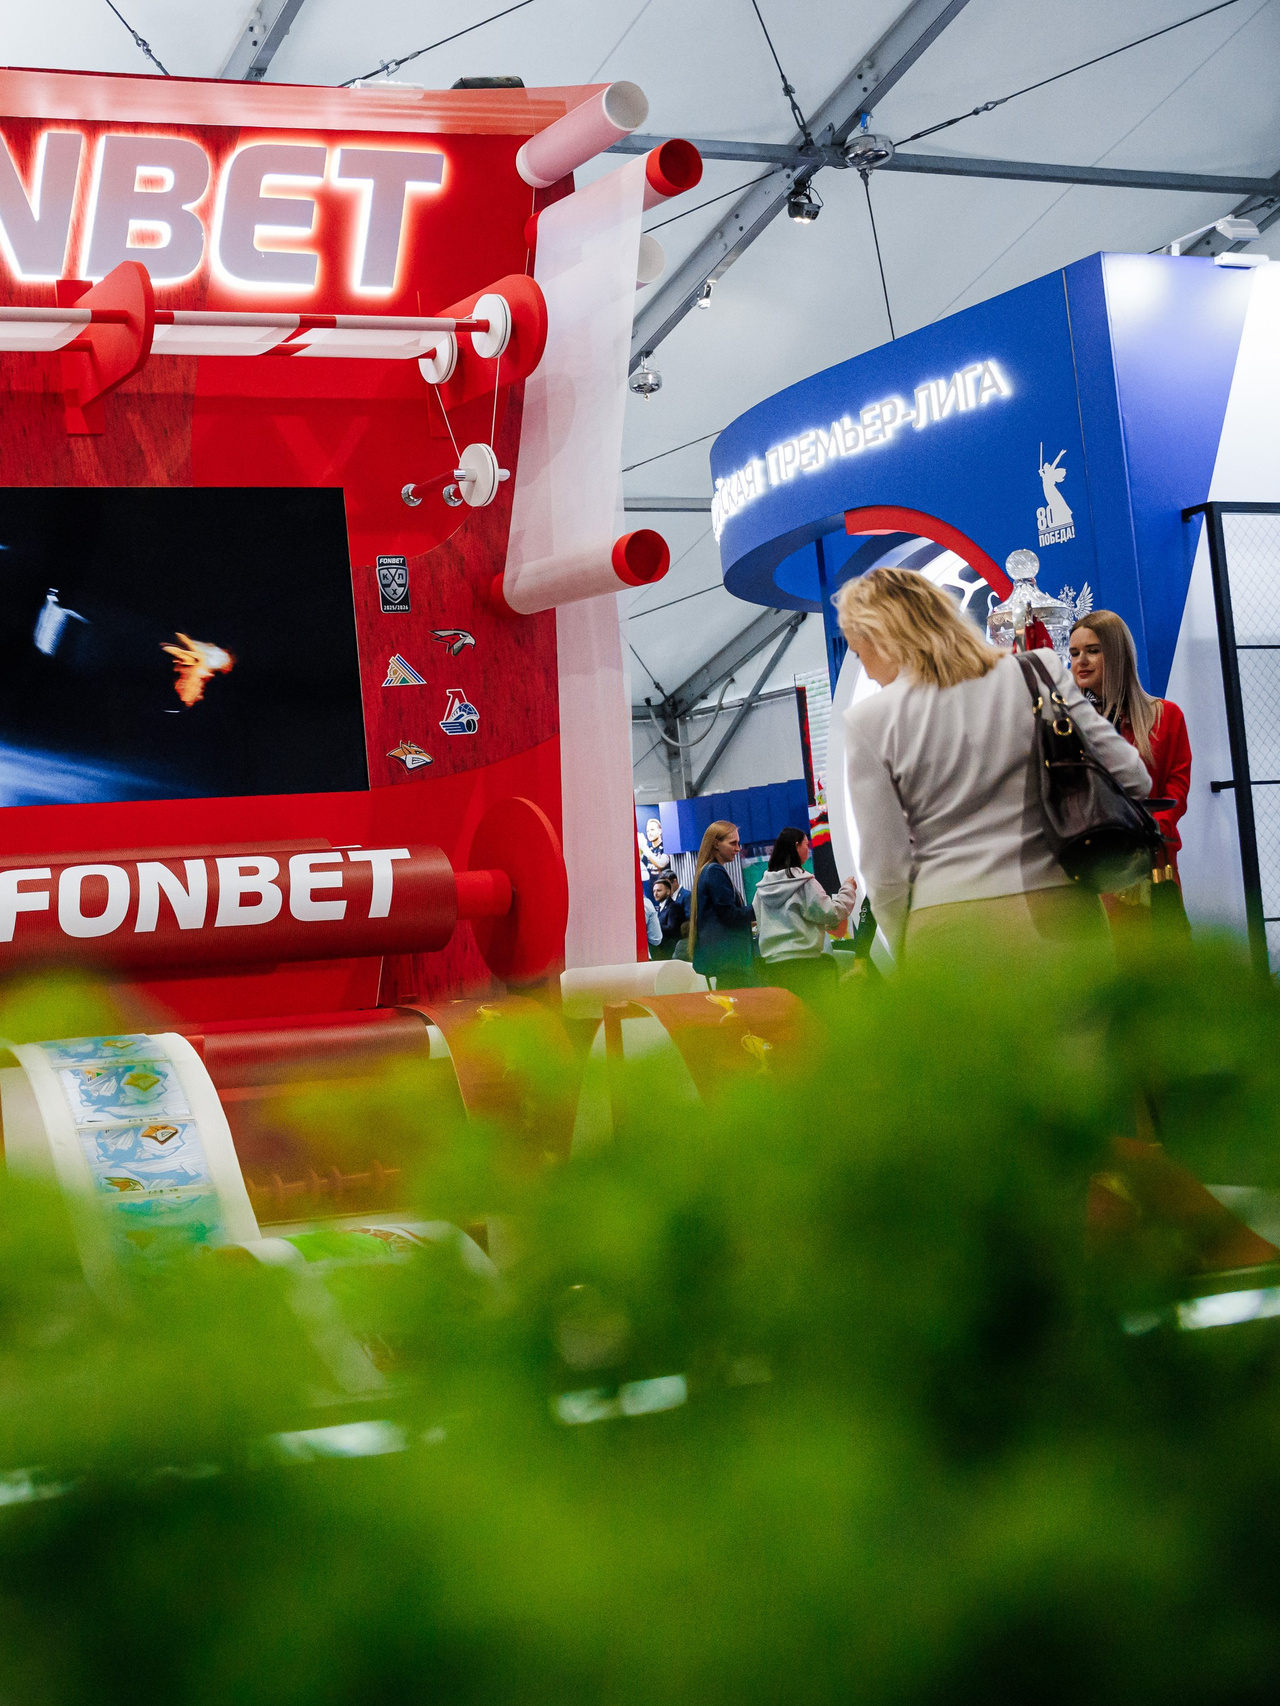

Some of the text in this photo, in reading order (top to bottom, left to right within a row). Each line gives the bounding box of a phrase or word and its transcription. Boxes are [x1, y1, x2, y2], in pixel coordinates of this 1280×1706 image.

[765, 360, 1009, 485] ПРЕМЬЕР-ЛИГА
[1036, 504, 1053, 530] 80
[1039, 526, 1075, 547] ПОБЕДА!
